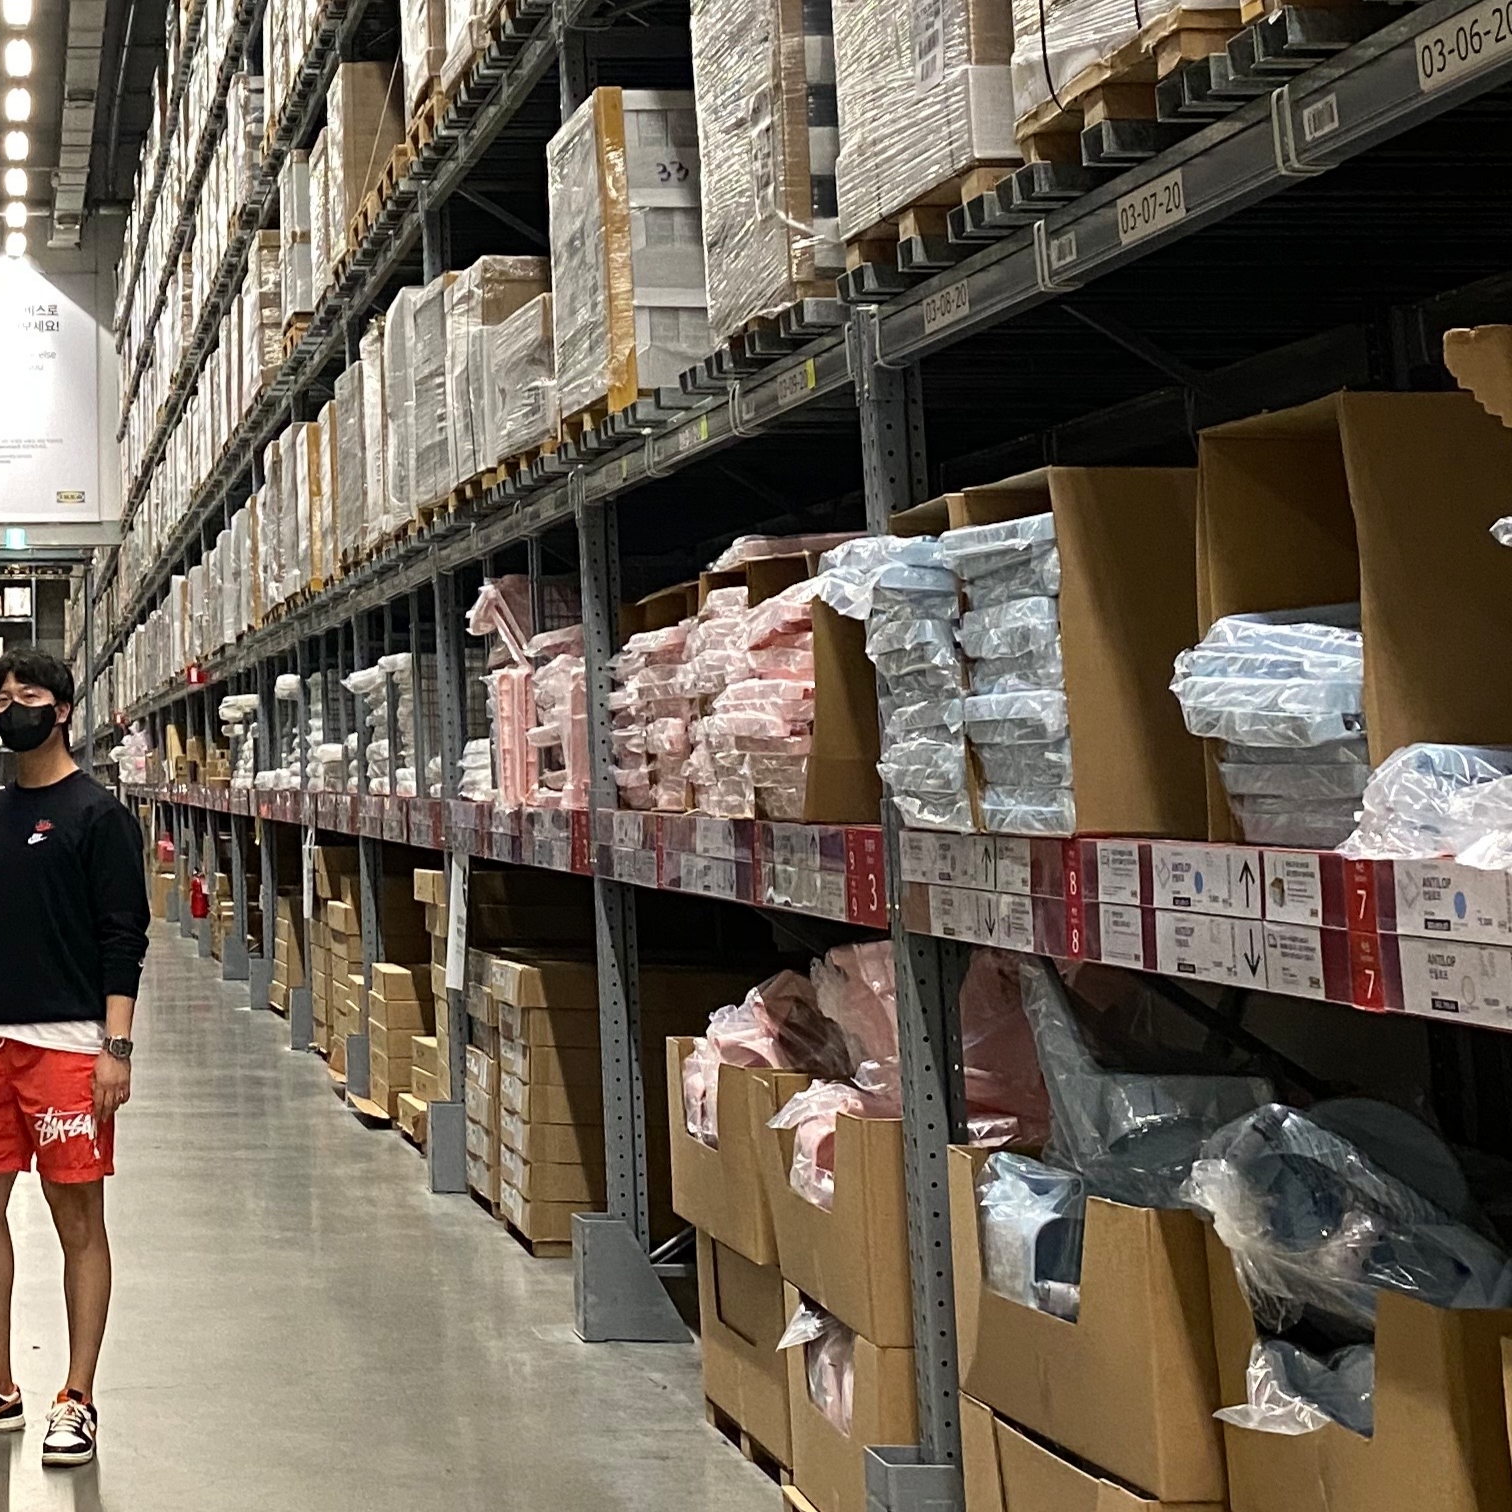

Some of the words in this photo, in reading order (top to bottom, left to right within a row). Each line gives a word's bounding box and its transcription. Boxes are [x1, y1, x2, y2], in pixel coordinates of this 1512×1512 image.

[1422, 0, 1512, 78] 03-06-20
[1121, 181, 1181, 234] 03-07-20
[926, 282, 967, 323] 03-08-20
[868, 873, 878, 912] 3
[1070, 871, 1077, 895] 8
[1356, 889, 1367, 920] 7
[1072, 929, 1079, 953] 8
[1364, 969, 1375, 999] 7
